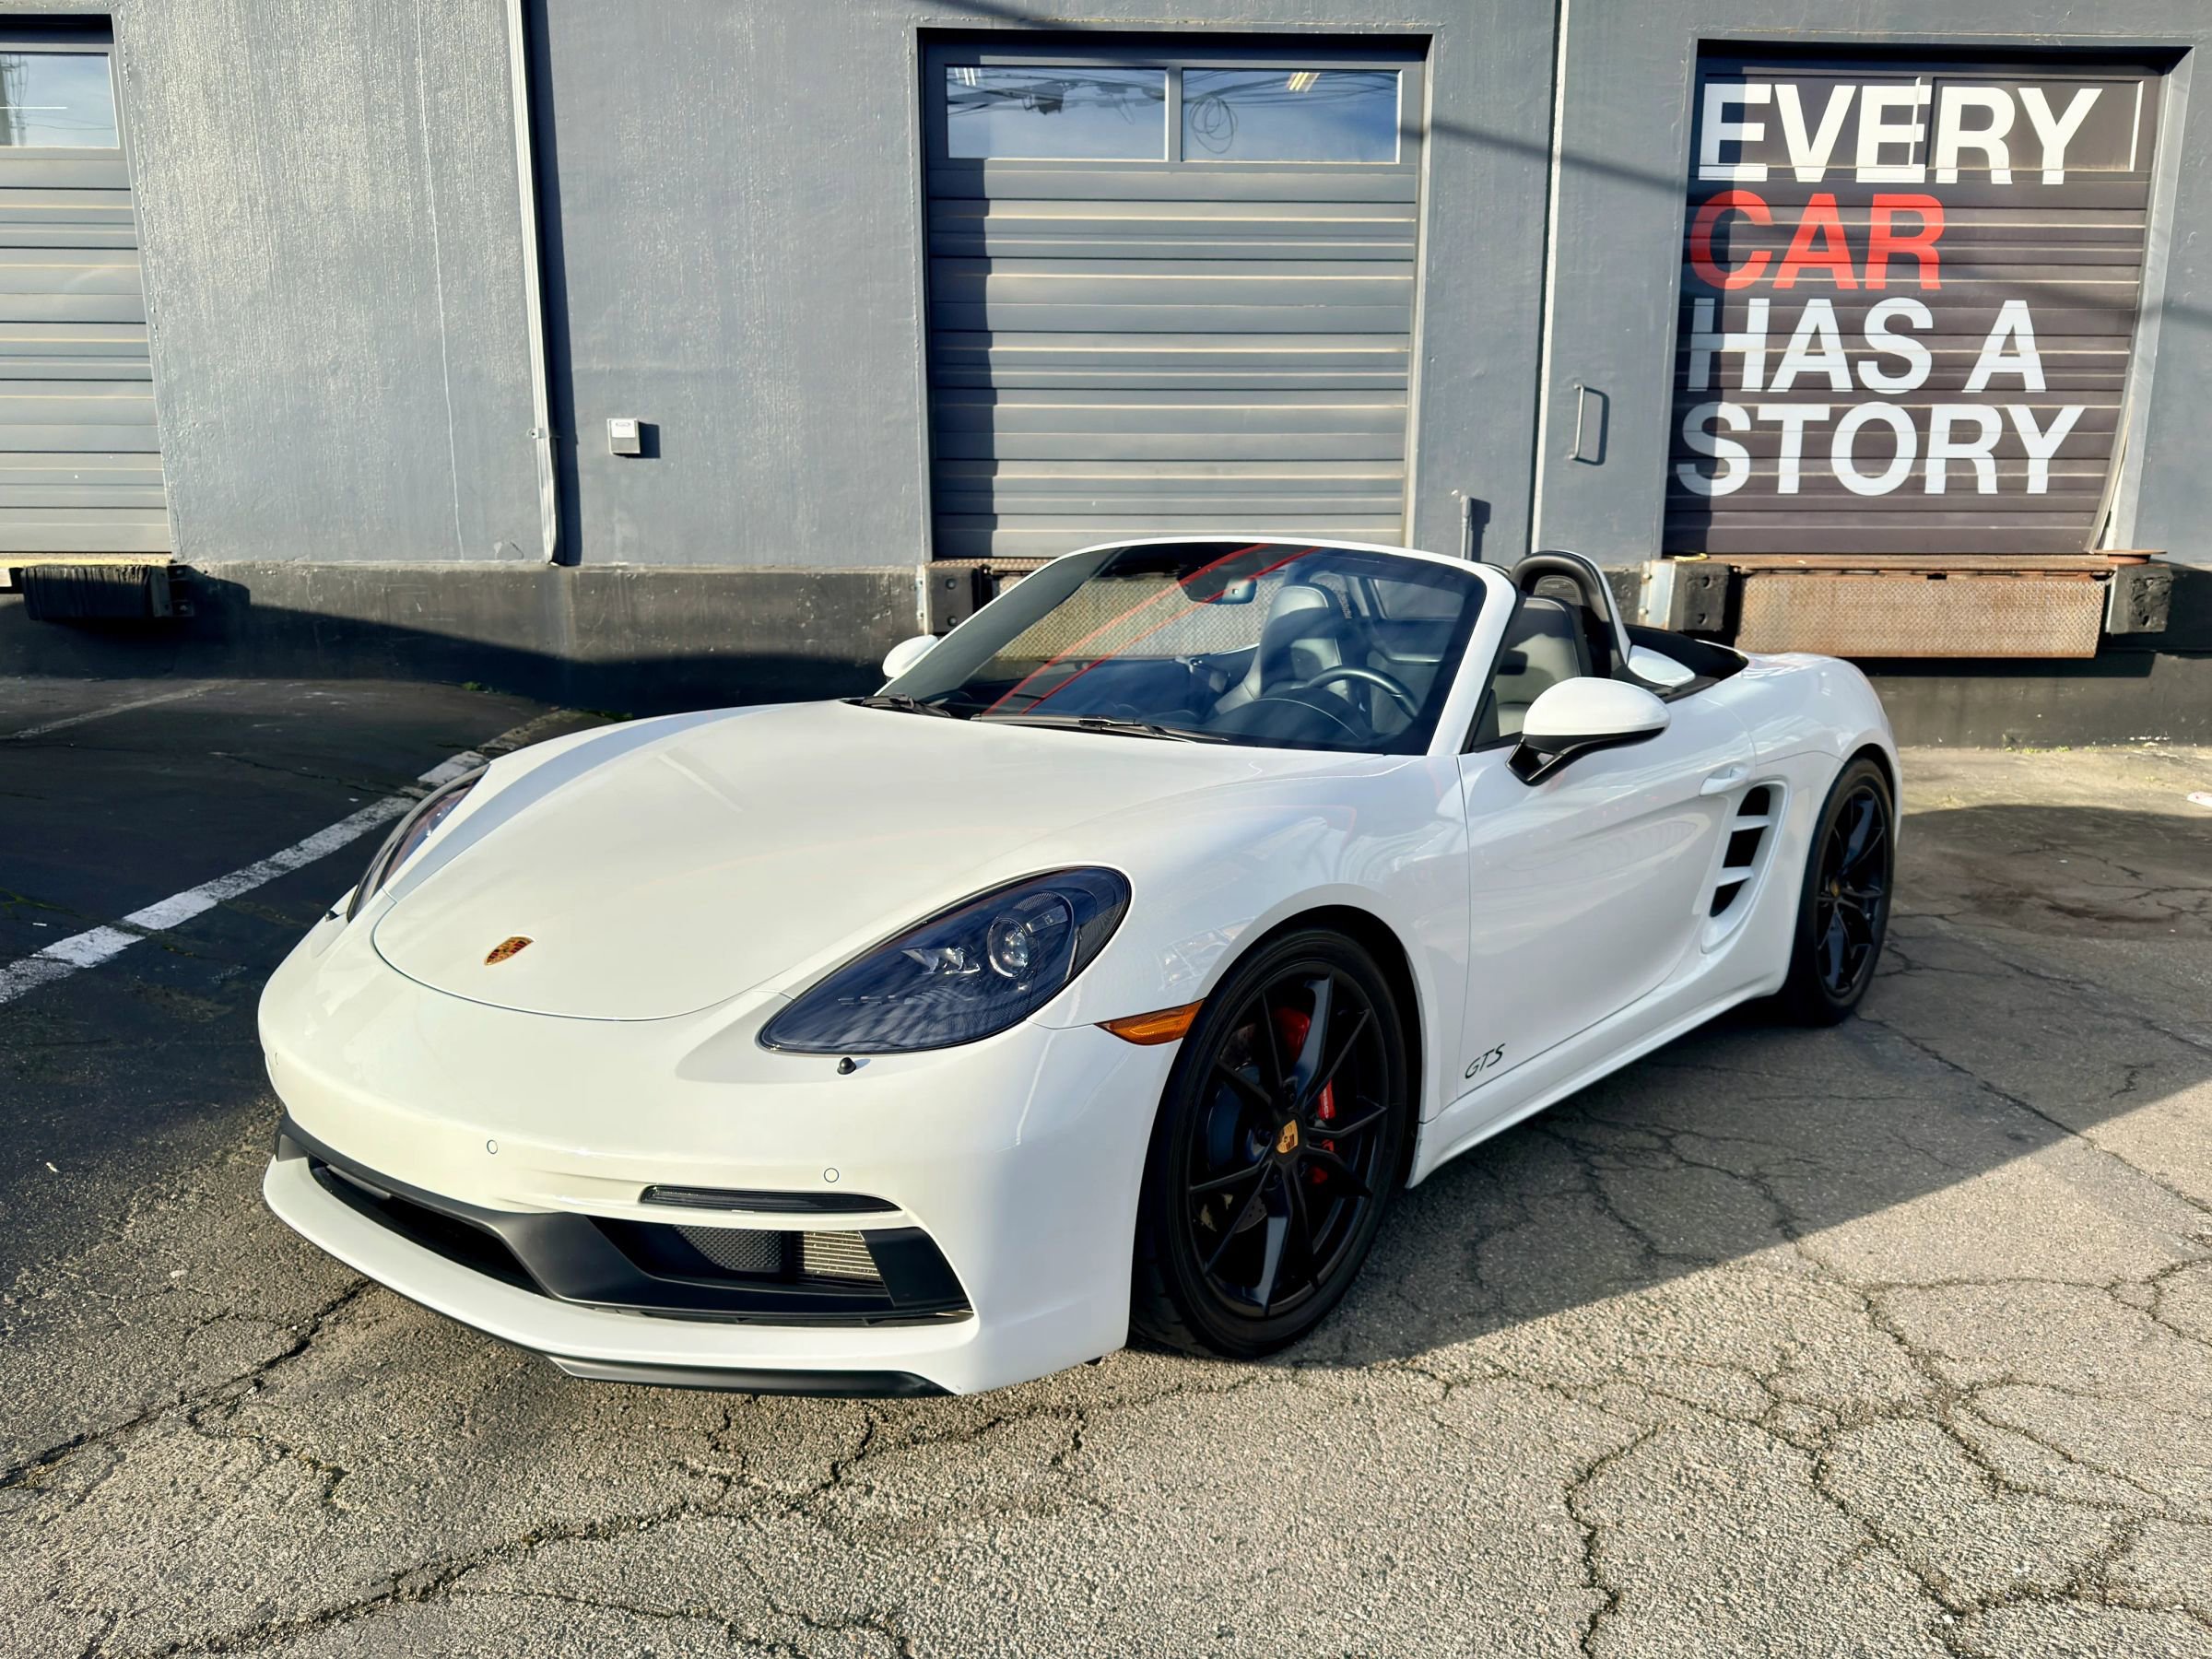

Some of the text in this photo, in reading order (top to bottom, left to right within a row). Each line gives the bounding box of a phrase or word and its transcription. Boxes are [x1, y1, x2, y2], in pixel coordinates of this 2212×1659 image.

[1698, 83, 2103, 185] EVERY
[1689, 190, 1946, 289] CAR
[1687, 297, 2047, 394] HAS A
[1676, 401, 2086, 496] STORY
[1465, 1042, 1506, 1079] GTS
